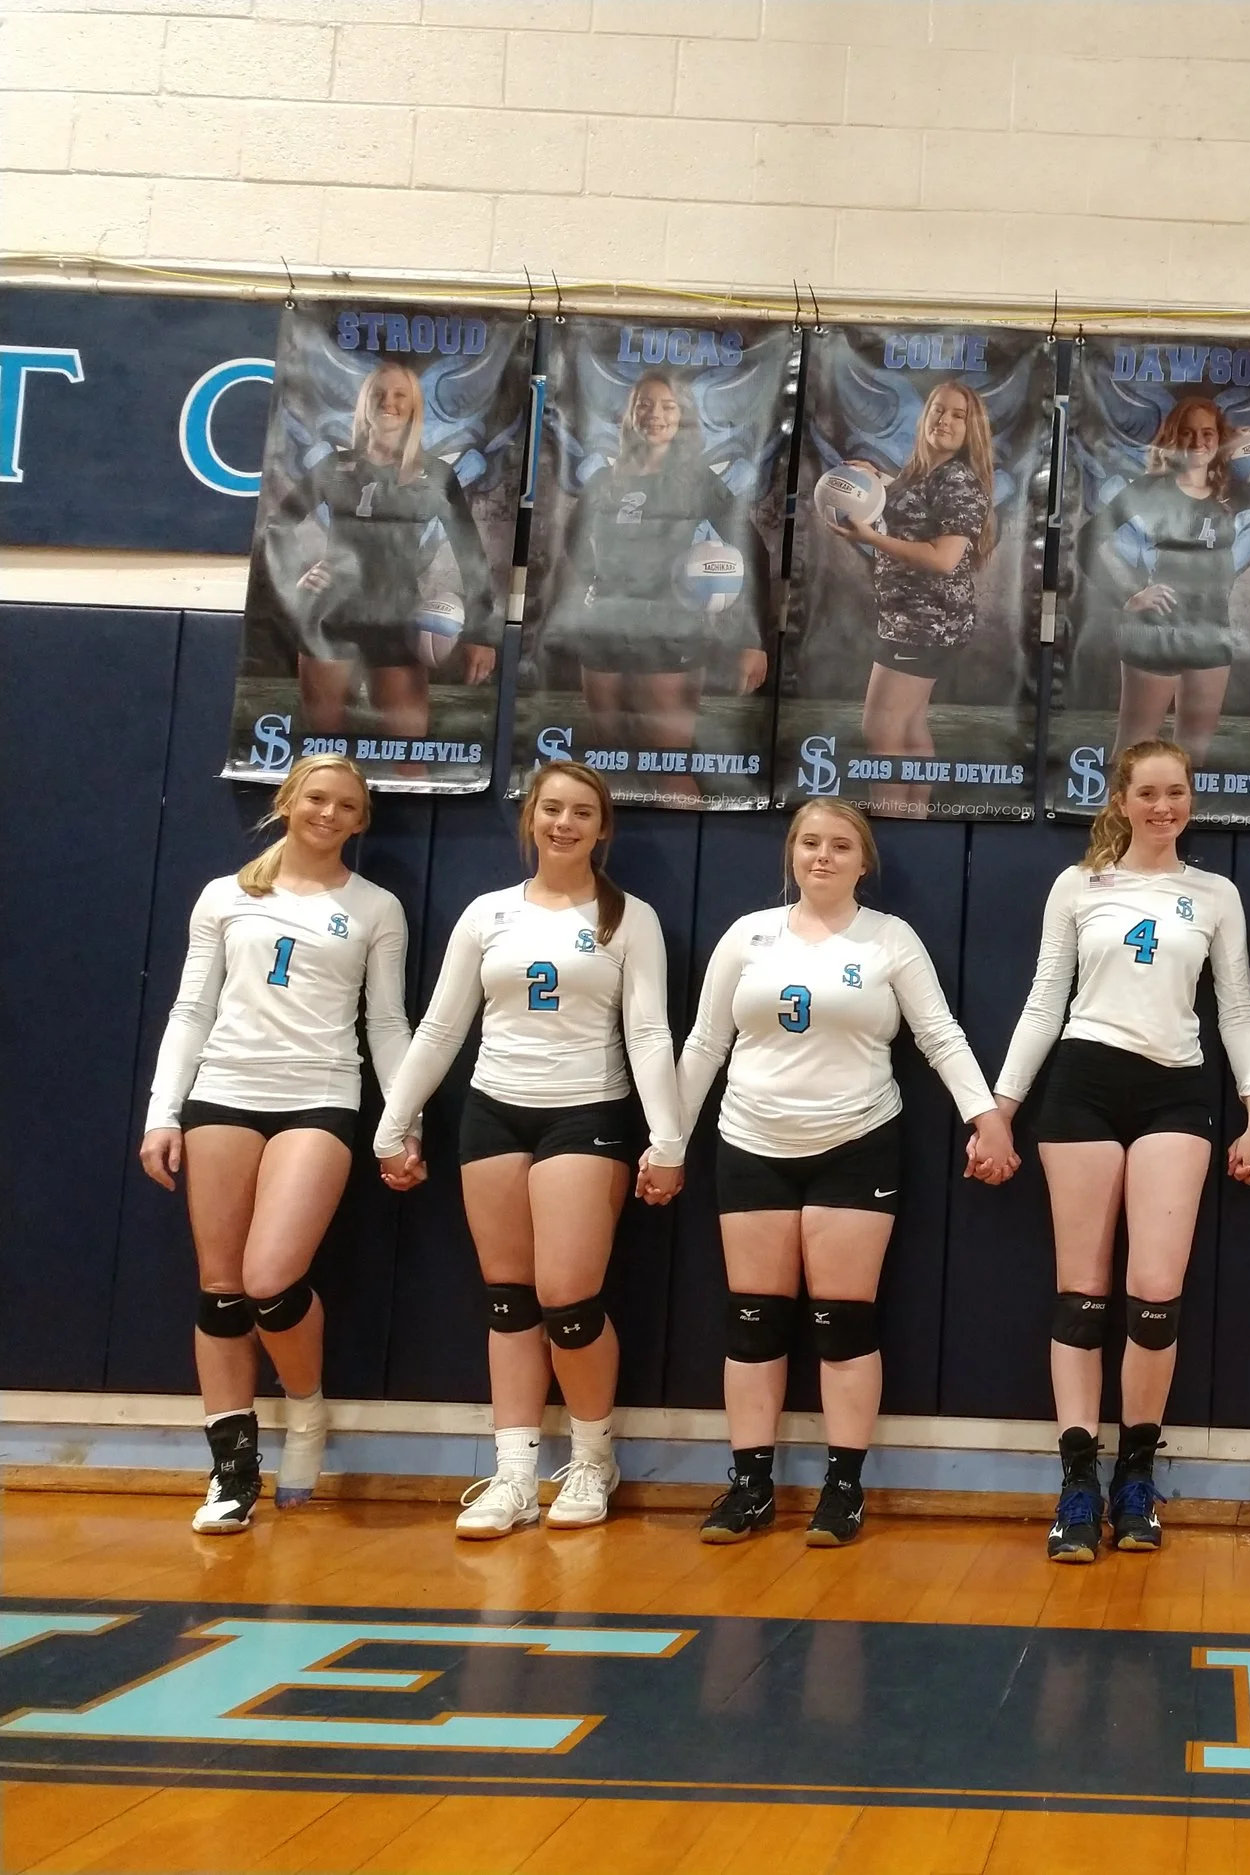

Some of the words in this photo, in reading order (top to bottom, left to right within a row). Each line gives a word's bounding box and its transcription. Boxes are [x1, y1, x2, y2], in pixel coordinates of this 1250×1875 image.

[336, 311, 488, 355] STROUD
[617, 328, 744, 367] LUCAS
[883, 335, 989, 372] COLIE
[356, 482, 378, 517] 1
[616, 491, 647, 524] 2
[1198, 518, 1216, 549] 4
[301, 737, 347, 757] 2019
[356, 739, 408, 761] BLUE
[410, 741, 482, 763] DEVILS
[584, 751, 629, 771] 2019
[637, 751, 687, 772] BLUE
[690, 753, 761, 775] DEVILS
[847, 759, 893, 779] 2019
[901, 761, 951, 782] BLUE
[954, 764, 1024, 784] DEVILS
[1194, 773, 1219, 792] UE
[1123, 919, 1158, 965] 4
[267, 936, 296, 988] 1
[526, 961, 560, 1011] 2
[777, 984, 812, 1033] 3
